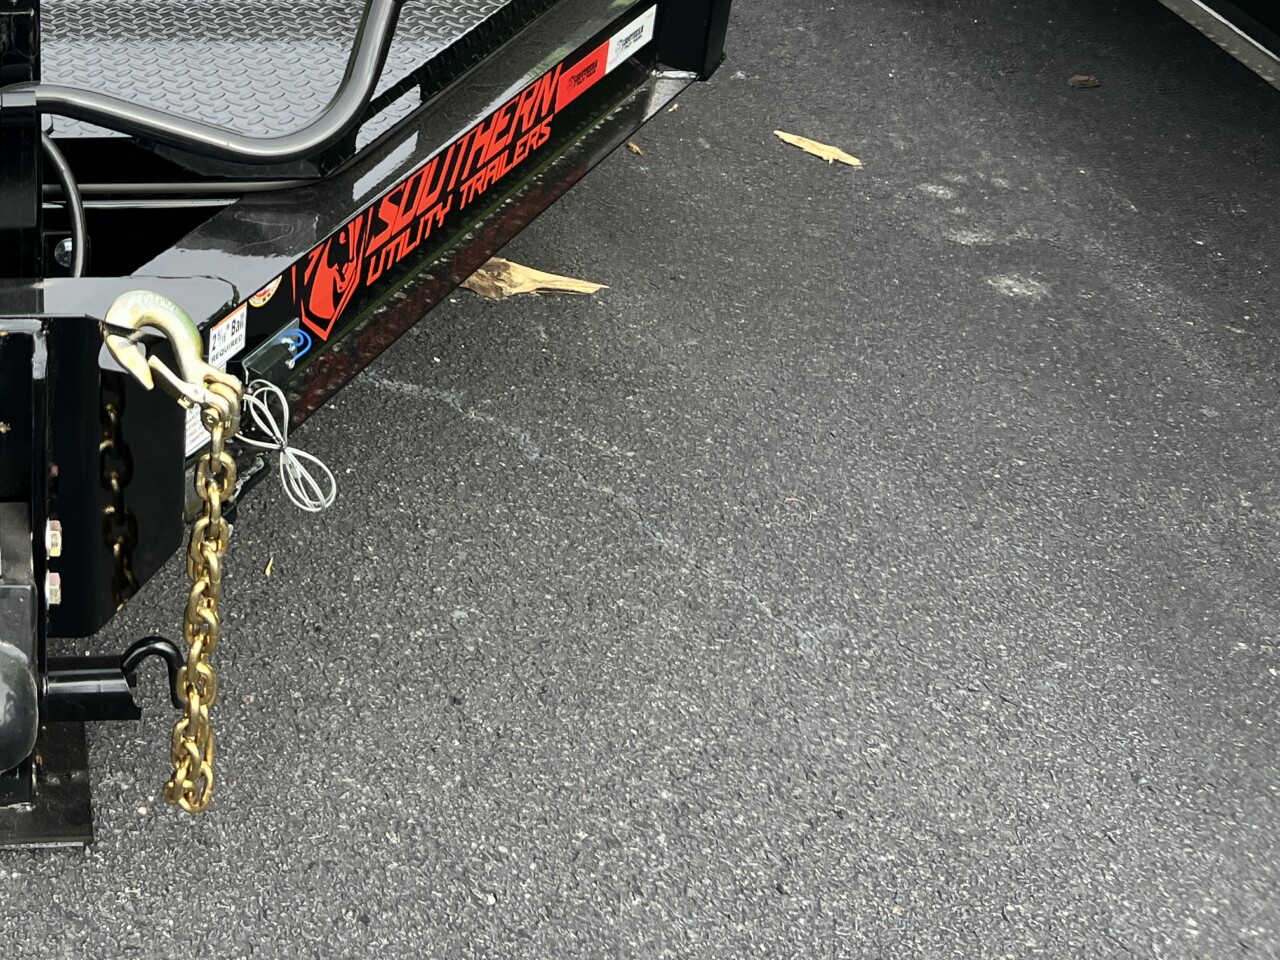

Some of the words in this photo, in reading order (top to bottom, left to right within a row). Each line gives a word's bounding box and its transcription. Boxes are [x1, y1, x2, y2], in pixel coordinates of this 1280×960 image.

[366, 62, 563, 256] SOUTHERN
[366, 196, 452, 286] UTILITY
[459, 115, 553, 210] TRAILERS
[211, 333, 243, 363] REQUIRED
[231, 312, 245, 337] Ball
